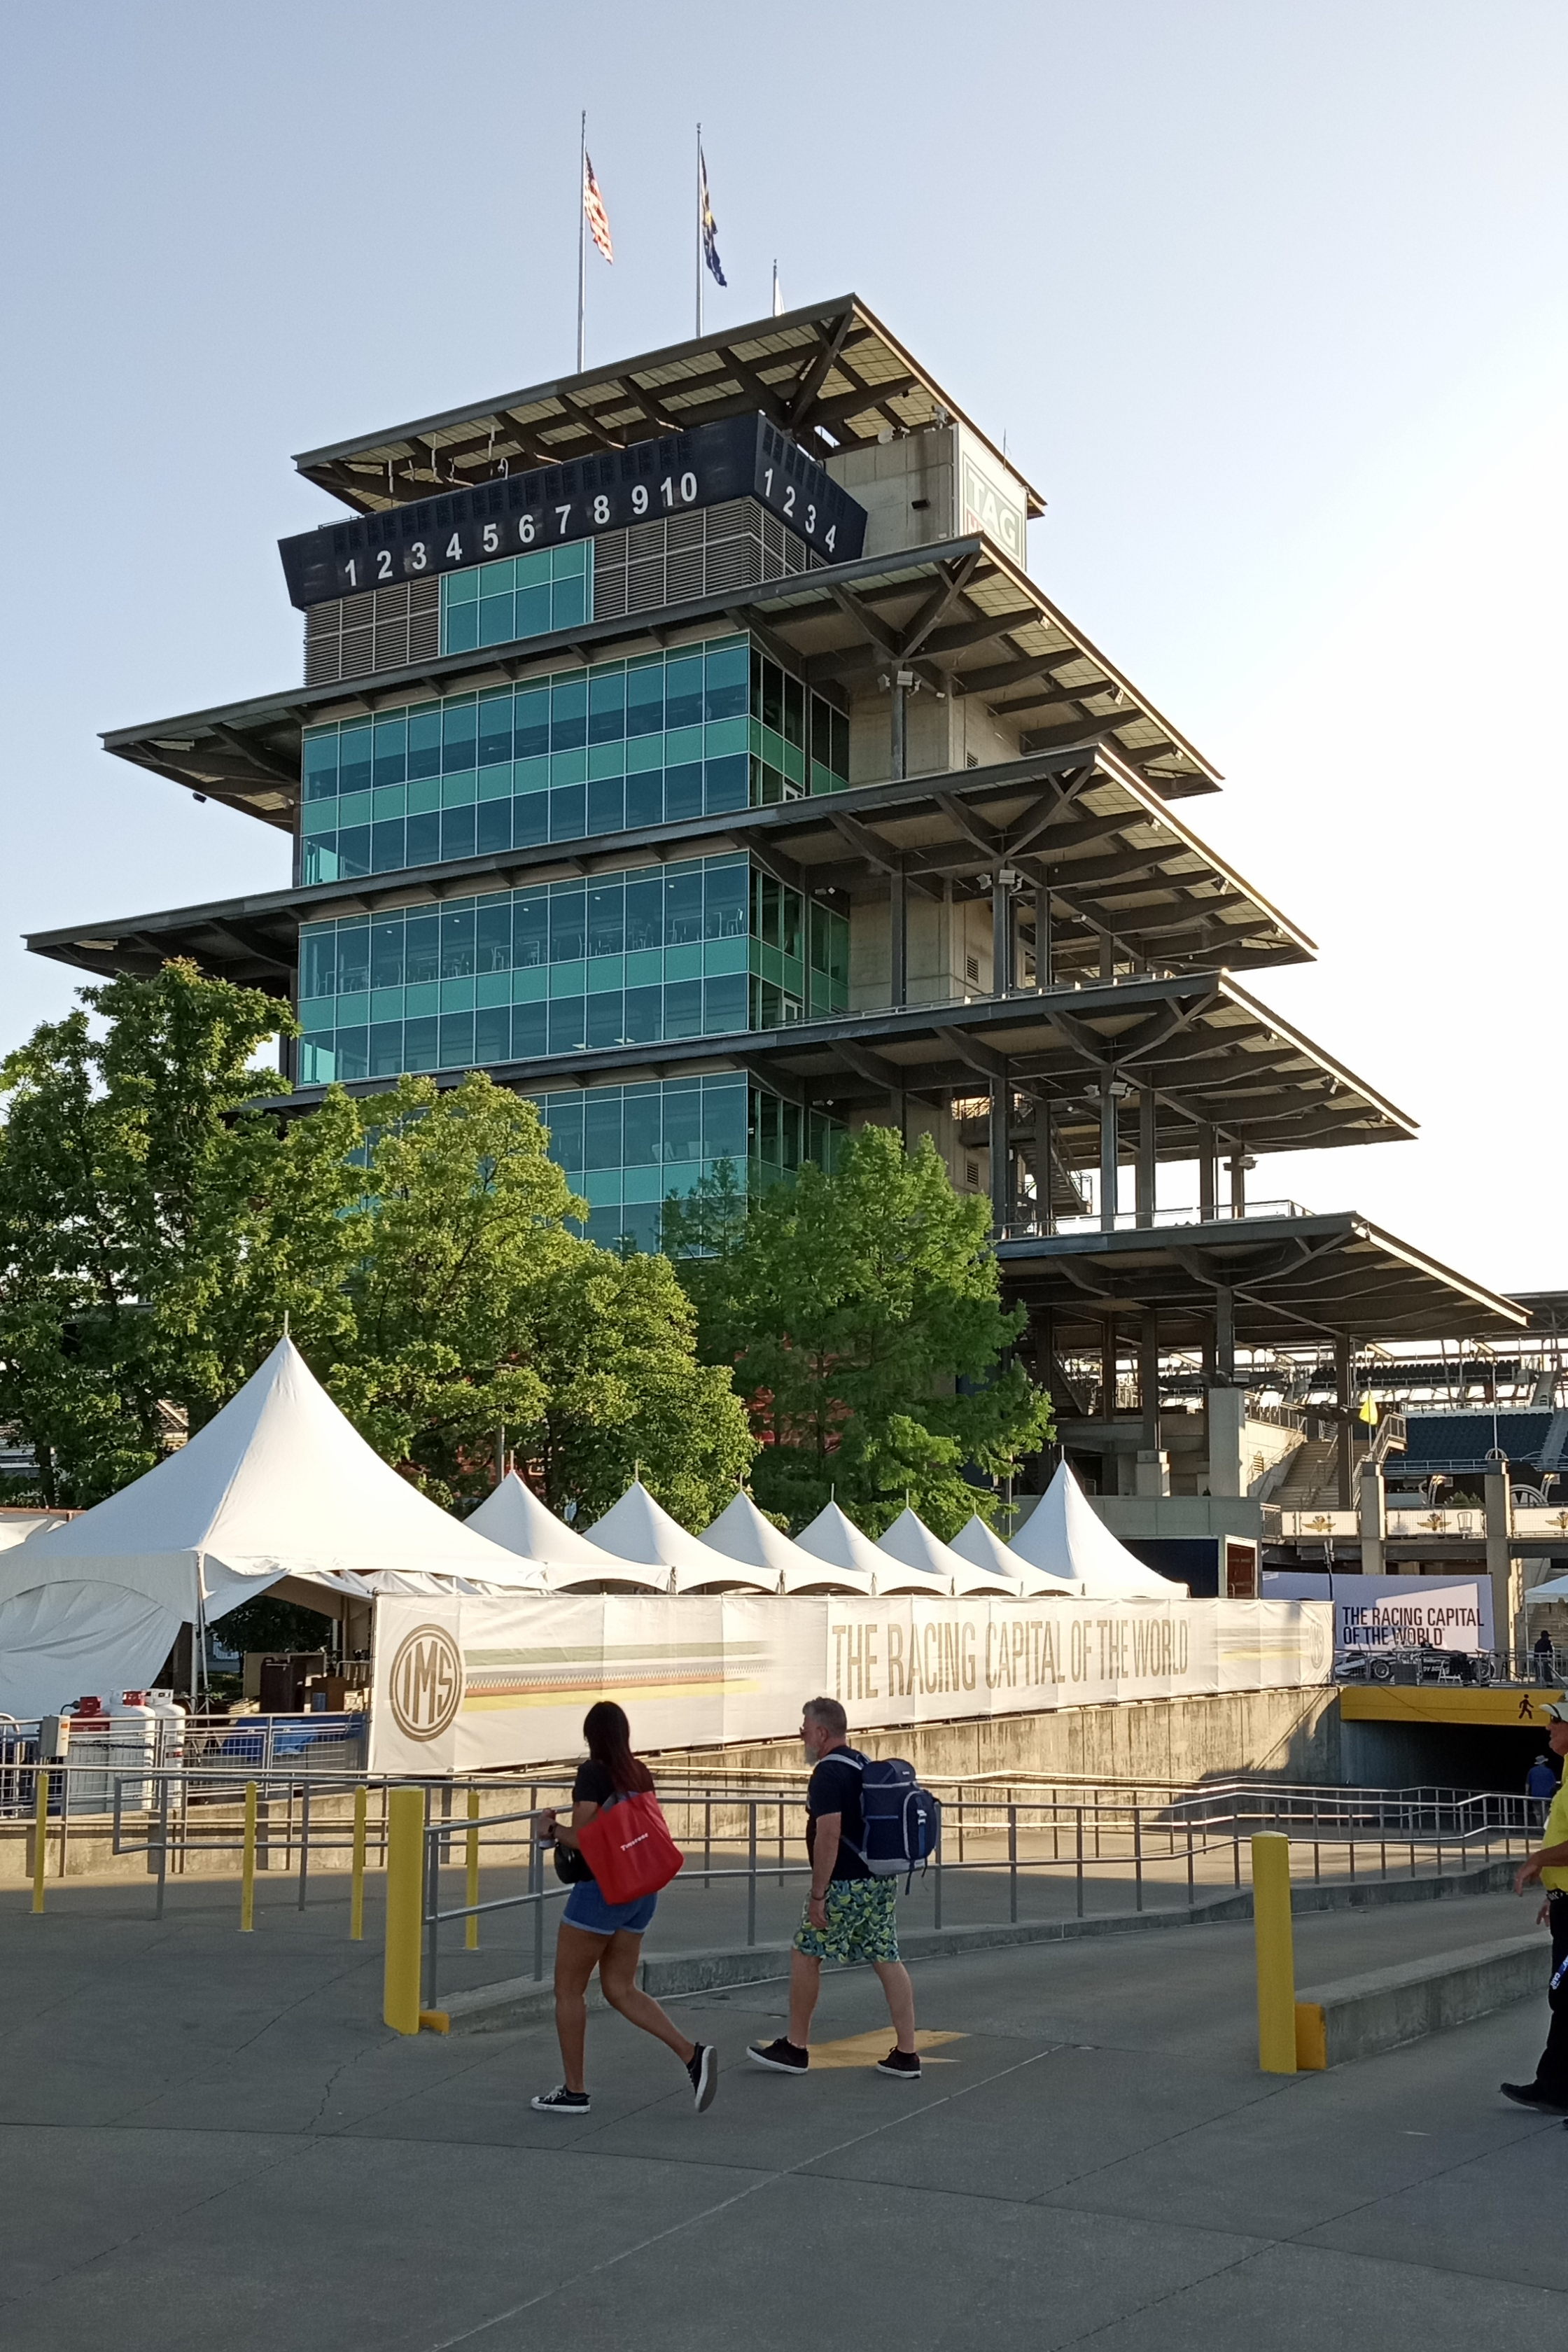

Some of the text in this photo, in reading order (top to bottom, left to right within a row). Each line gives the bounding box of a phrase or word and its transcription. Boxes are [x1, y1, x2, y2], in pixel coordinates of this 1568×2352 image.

[344, 471, 698, 587] 1 2 3 4 5 6 7 8 9 10
[764, 467, 836, 553] 1 2 3 4
[968, 466, 1016, 552] TAG
[1342, 1606, 1484, 1627] THE RACING CAPITAL
[1343, 1626, 1443, 1646] OF THE WORLD
[402, 1640, 453, 1725] IMS
[832, 1618, 1189, 1701] THE RACING CAPITAL OF THE WORLD
